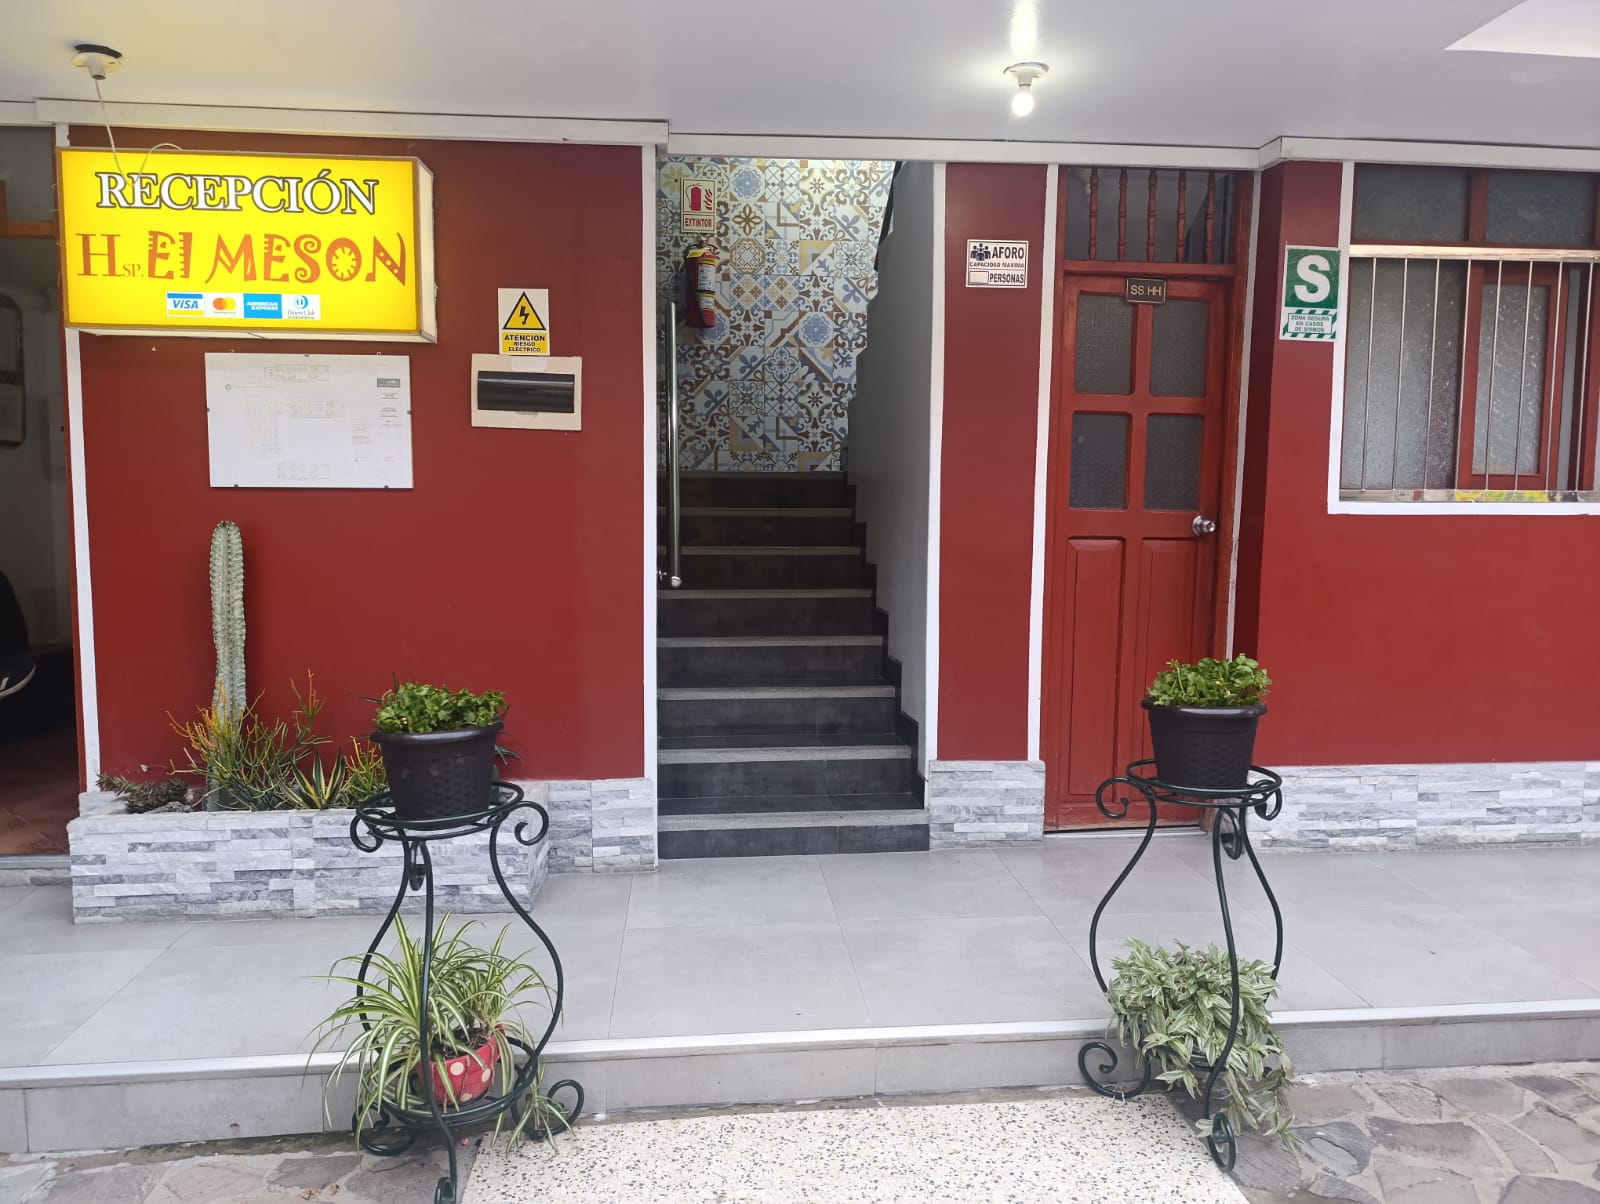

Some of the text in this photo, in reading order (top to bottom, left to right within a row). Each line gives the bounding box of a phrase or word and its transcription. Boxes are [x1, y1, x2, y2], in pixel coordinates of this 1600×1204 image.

[95, 169, 379, 215] RECEPCIÓN
[685, 218, 712, 227] EXTINTOR
[205, 231, 407, 287] MESON
[992, 247, 1024, 259] AFORO
[989, 274, 1024, 283] PERSONAS
[1294, 254, 1331, 303] S
[173, 299, 199, 310] VISA
